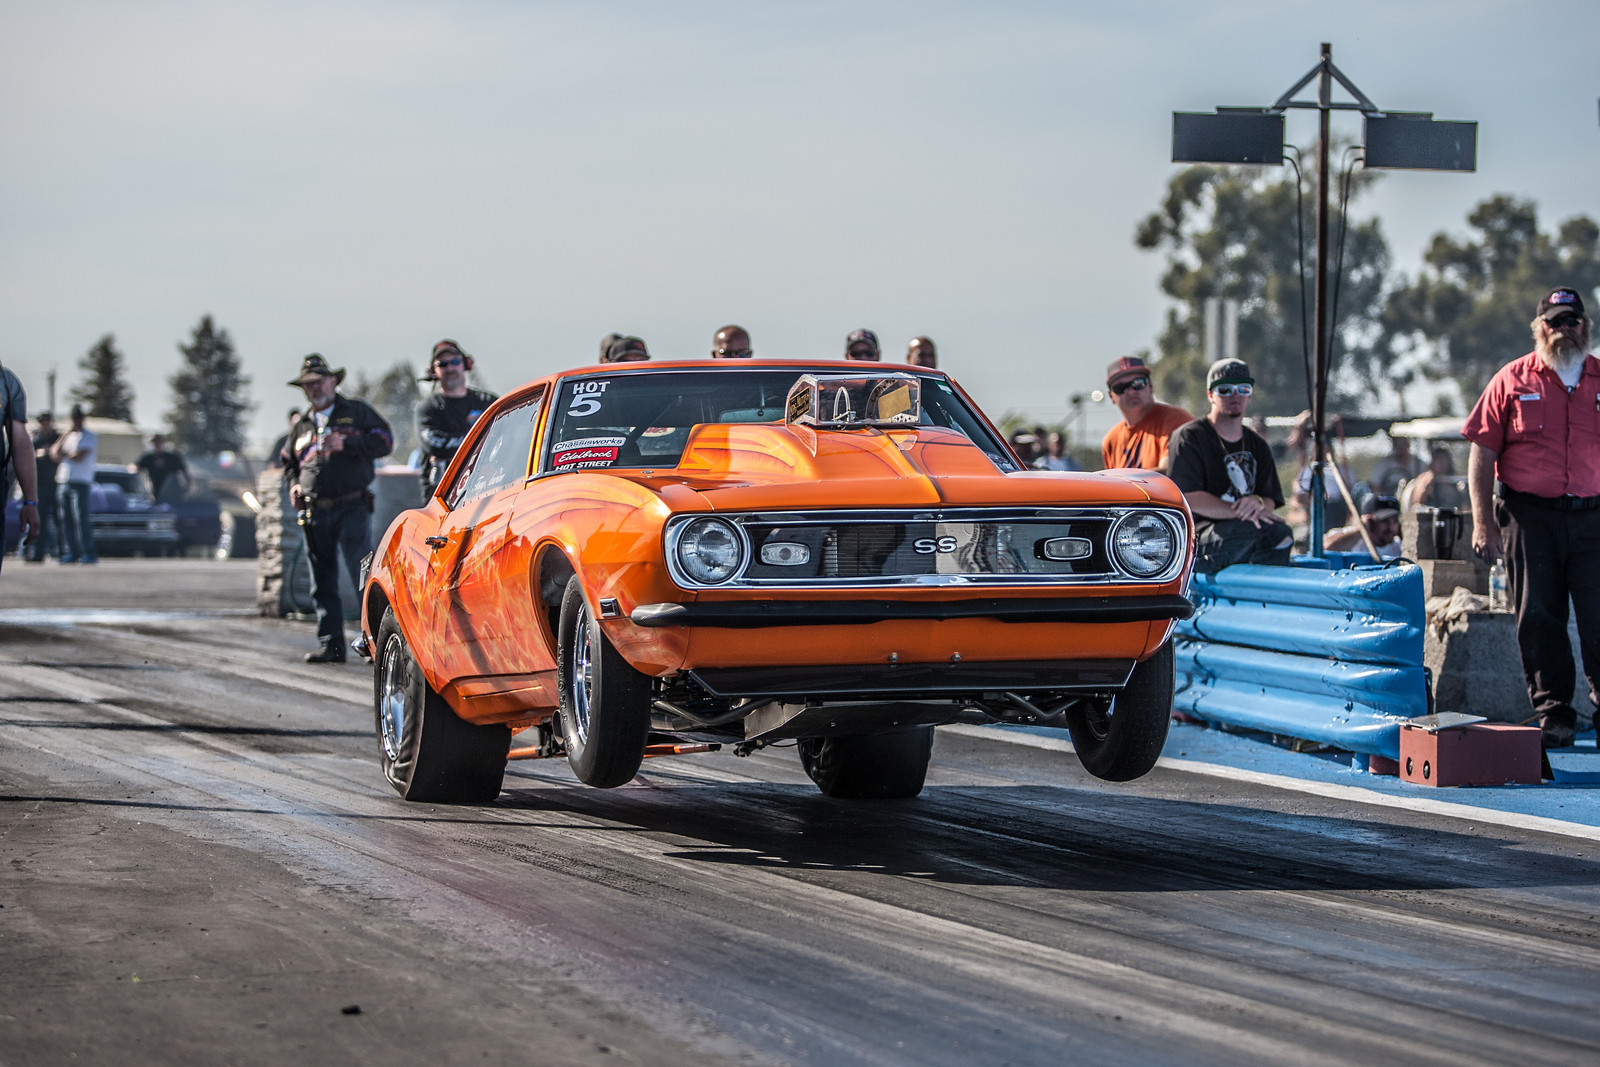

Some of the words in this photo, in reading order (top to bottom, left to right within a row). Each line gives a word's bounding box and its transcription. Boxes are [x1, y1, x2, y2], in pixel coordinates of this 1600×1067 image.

[573, 381, 610, 394] HOT
[567, 392, 601, 416] 5
[558, 450, 612, 462] Edelbrock
[555, 463, 577, 471] HOT
[913, 536, 957, 554] SS
